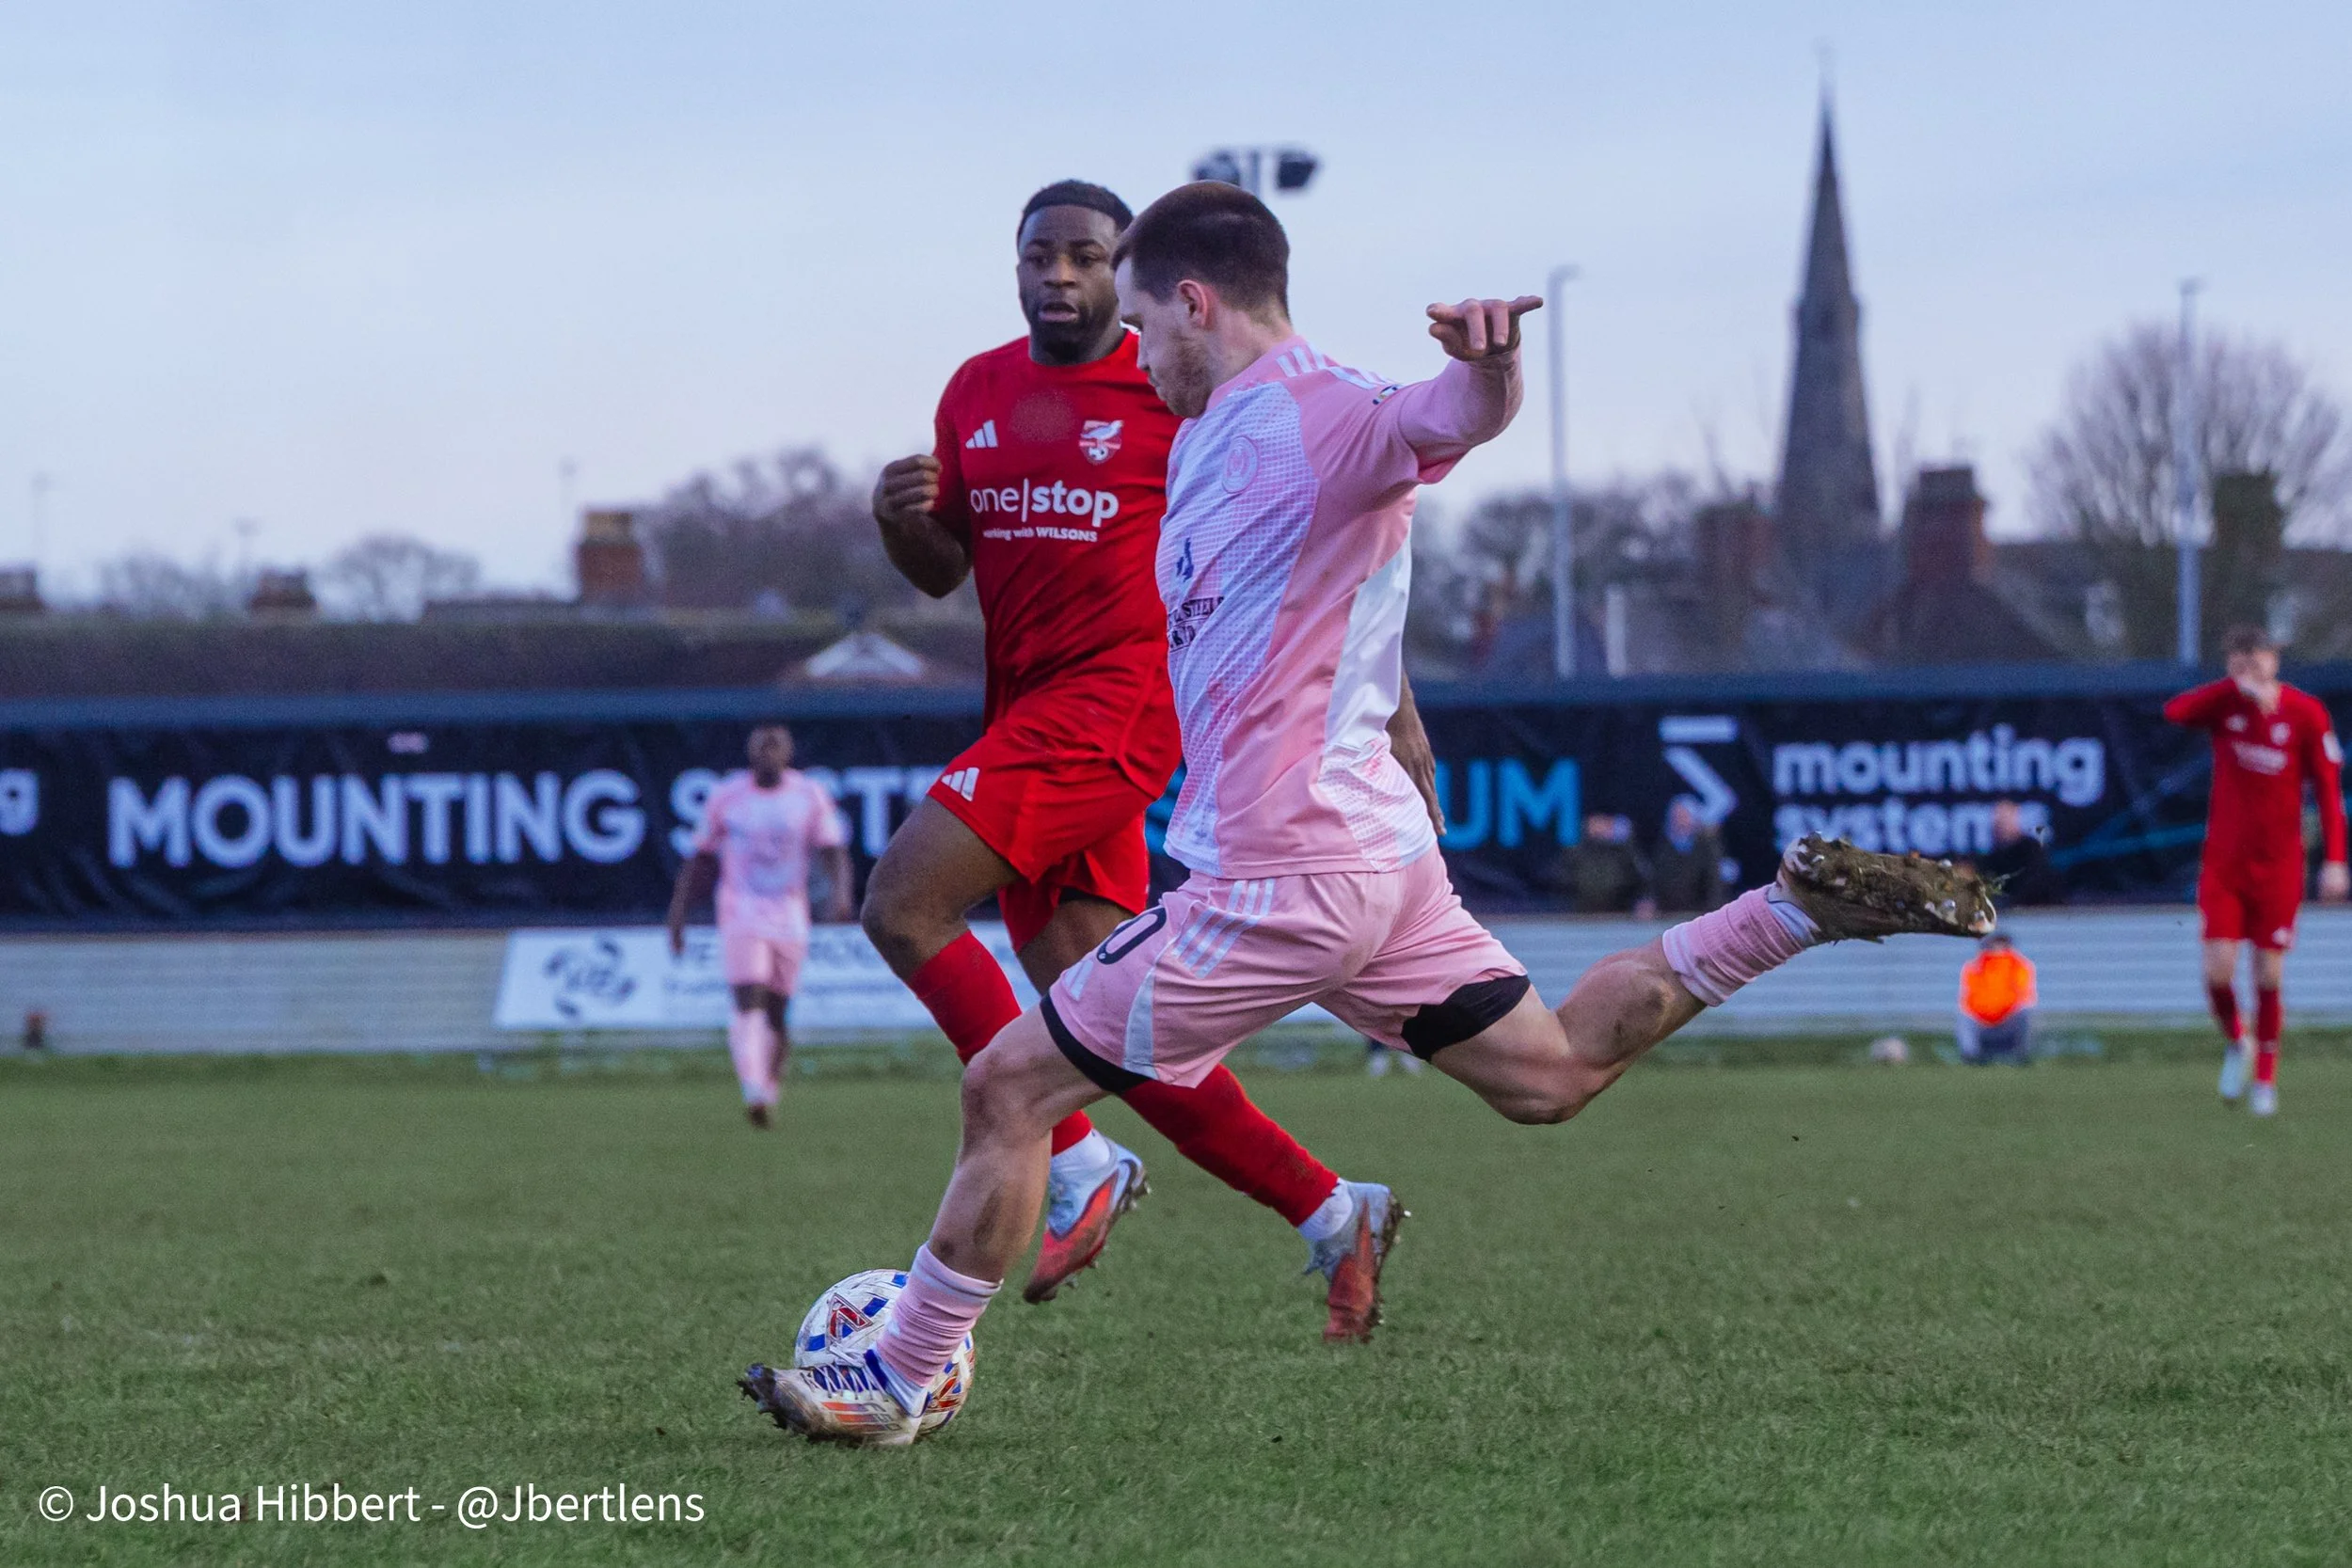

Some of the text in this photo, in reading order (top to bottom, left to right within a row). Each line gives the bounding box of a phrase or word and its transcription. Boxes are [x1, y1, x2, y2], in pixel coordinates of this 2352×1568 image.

[1036, 527, 1099, 543] WILSONS
[1772, 721, 2105, 807] mounting
[107, 770, 646, 868] MOUNTING
